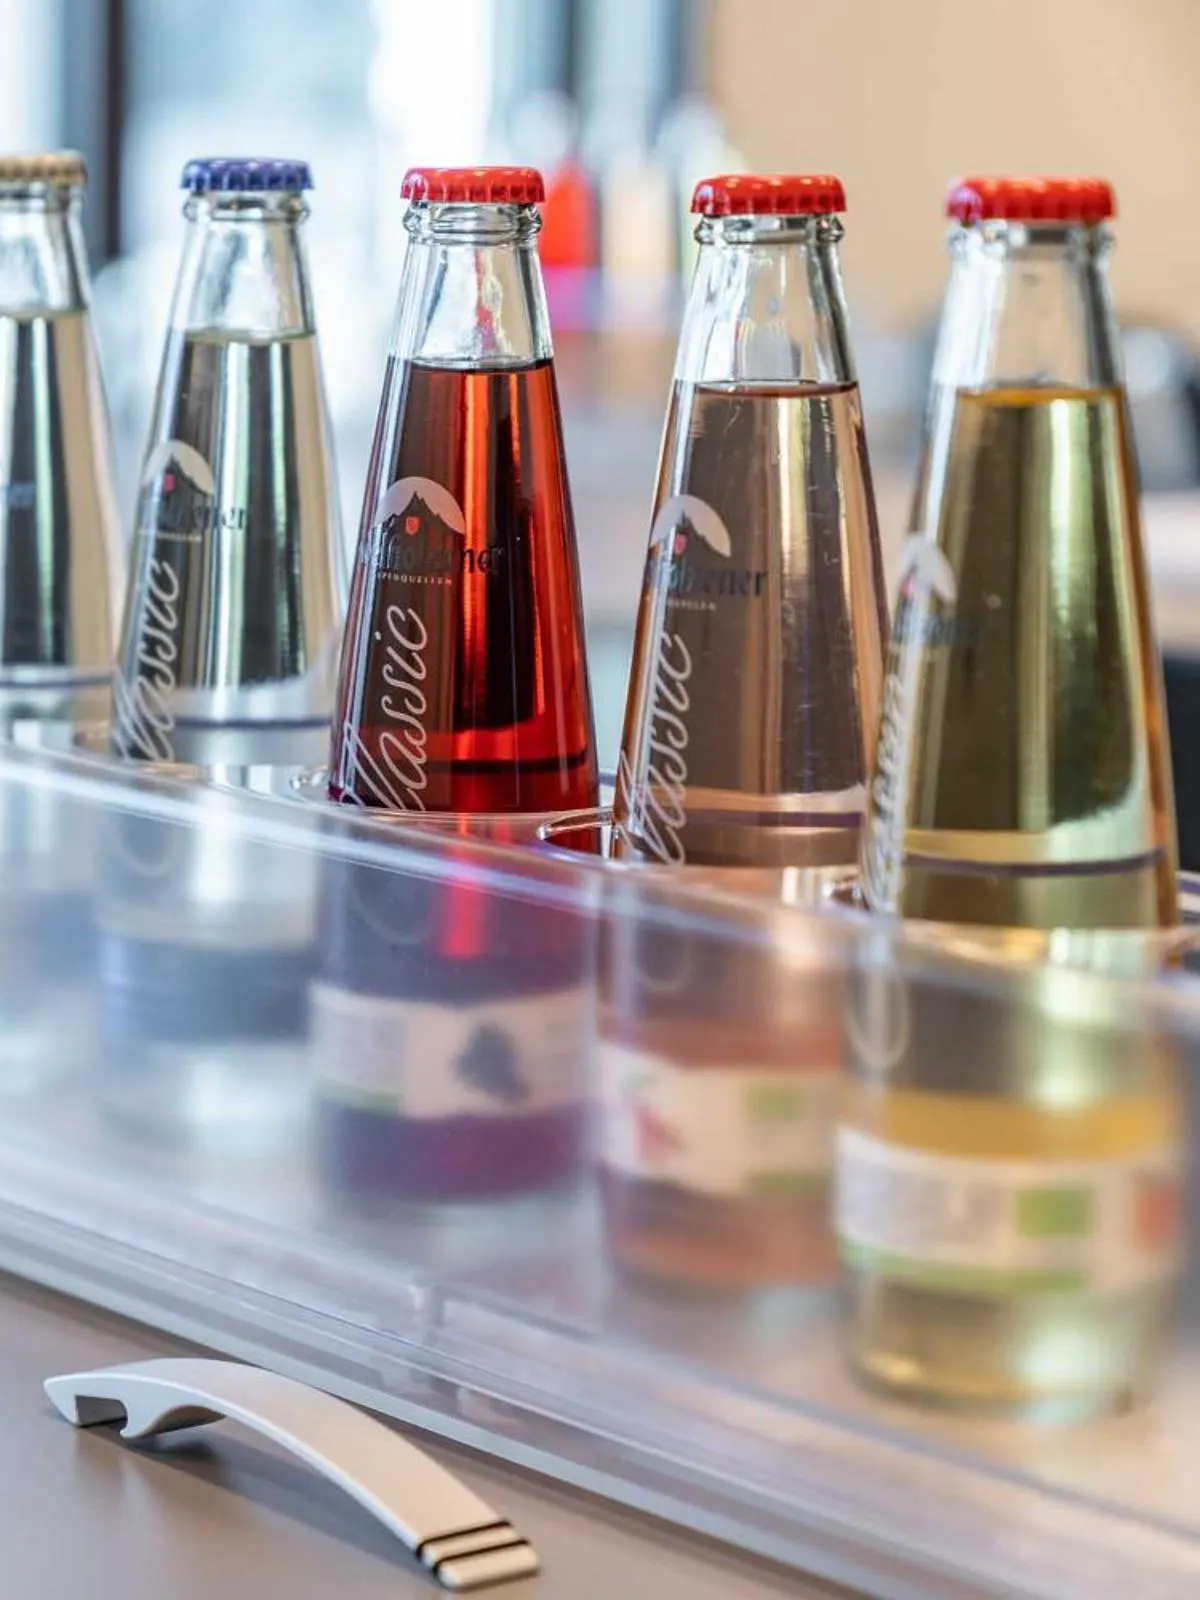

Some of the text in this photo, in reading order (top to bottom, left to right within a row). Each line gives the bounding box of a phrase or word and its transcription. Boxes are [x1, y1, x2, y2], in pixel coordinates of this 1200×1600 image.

[113, 558, 180, 762] lassic
[341, 604, 428, 811] lassic
[616, 632, 692, 865] lassic
